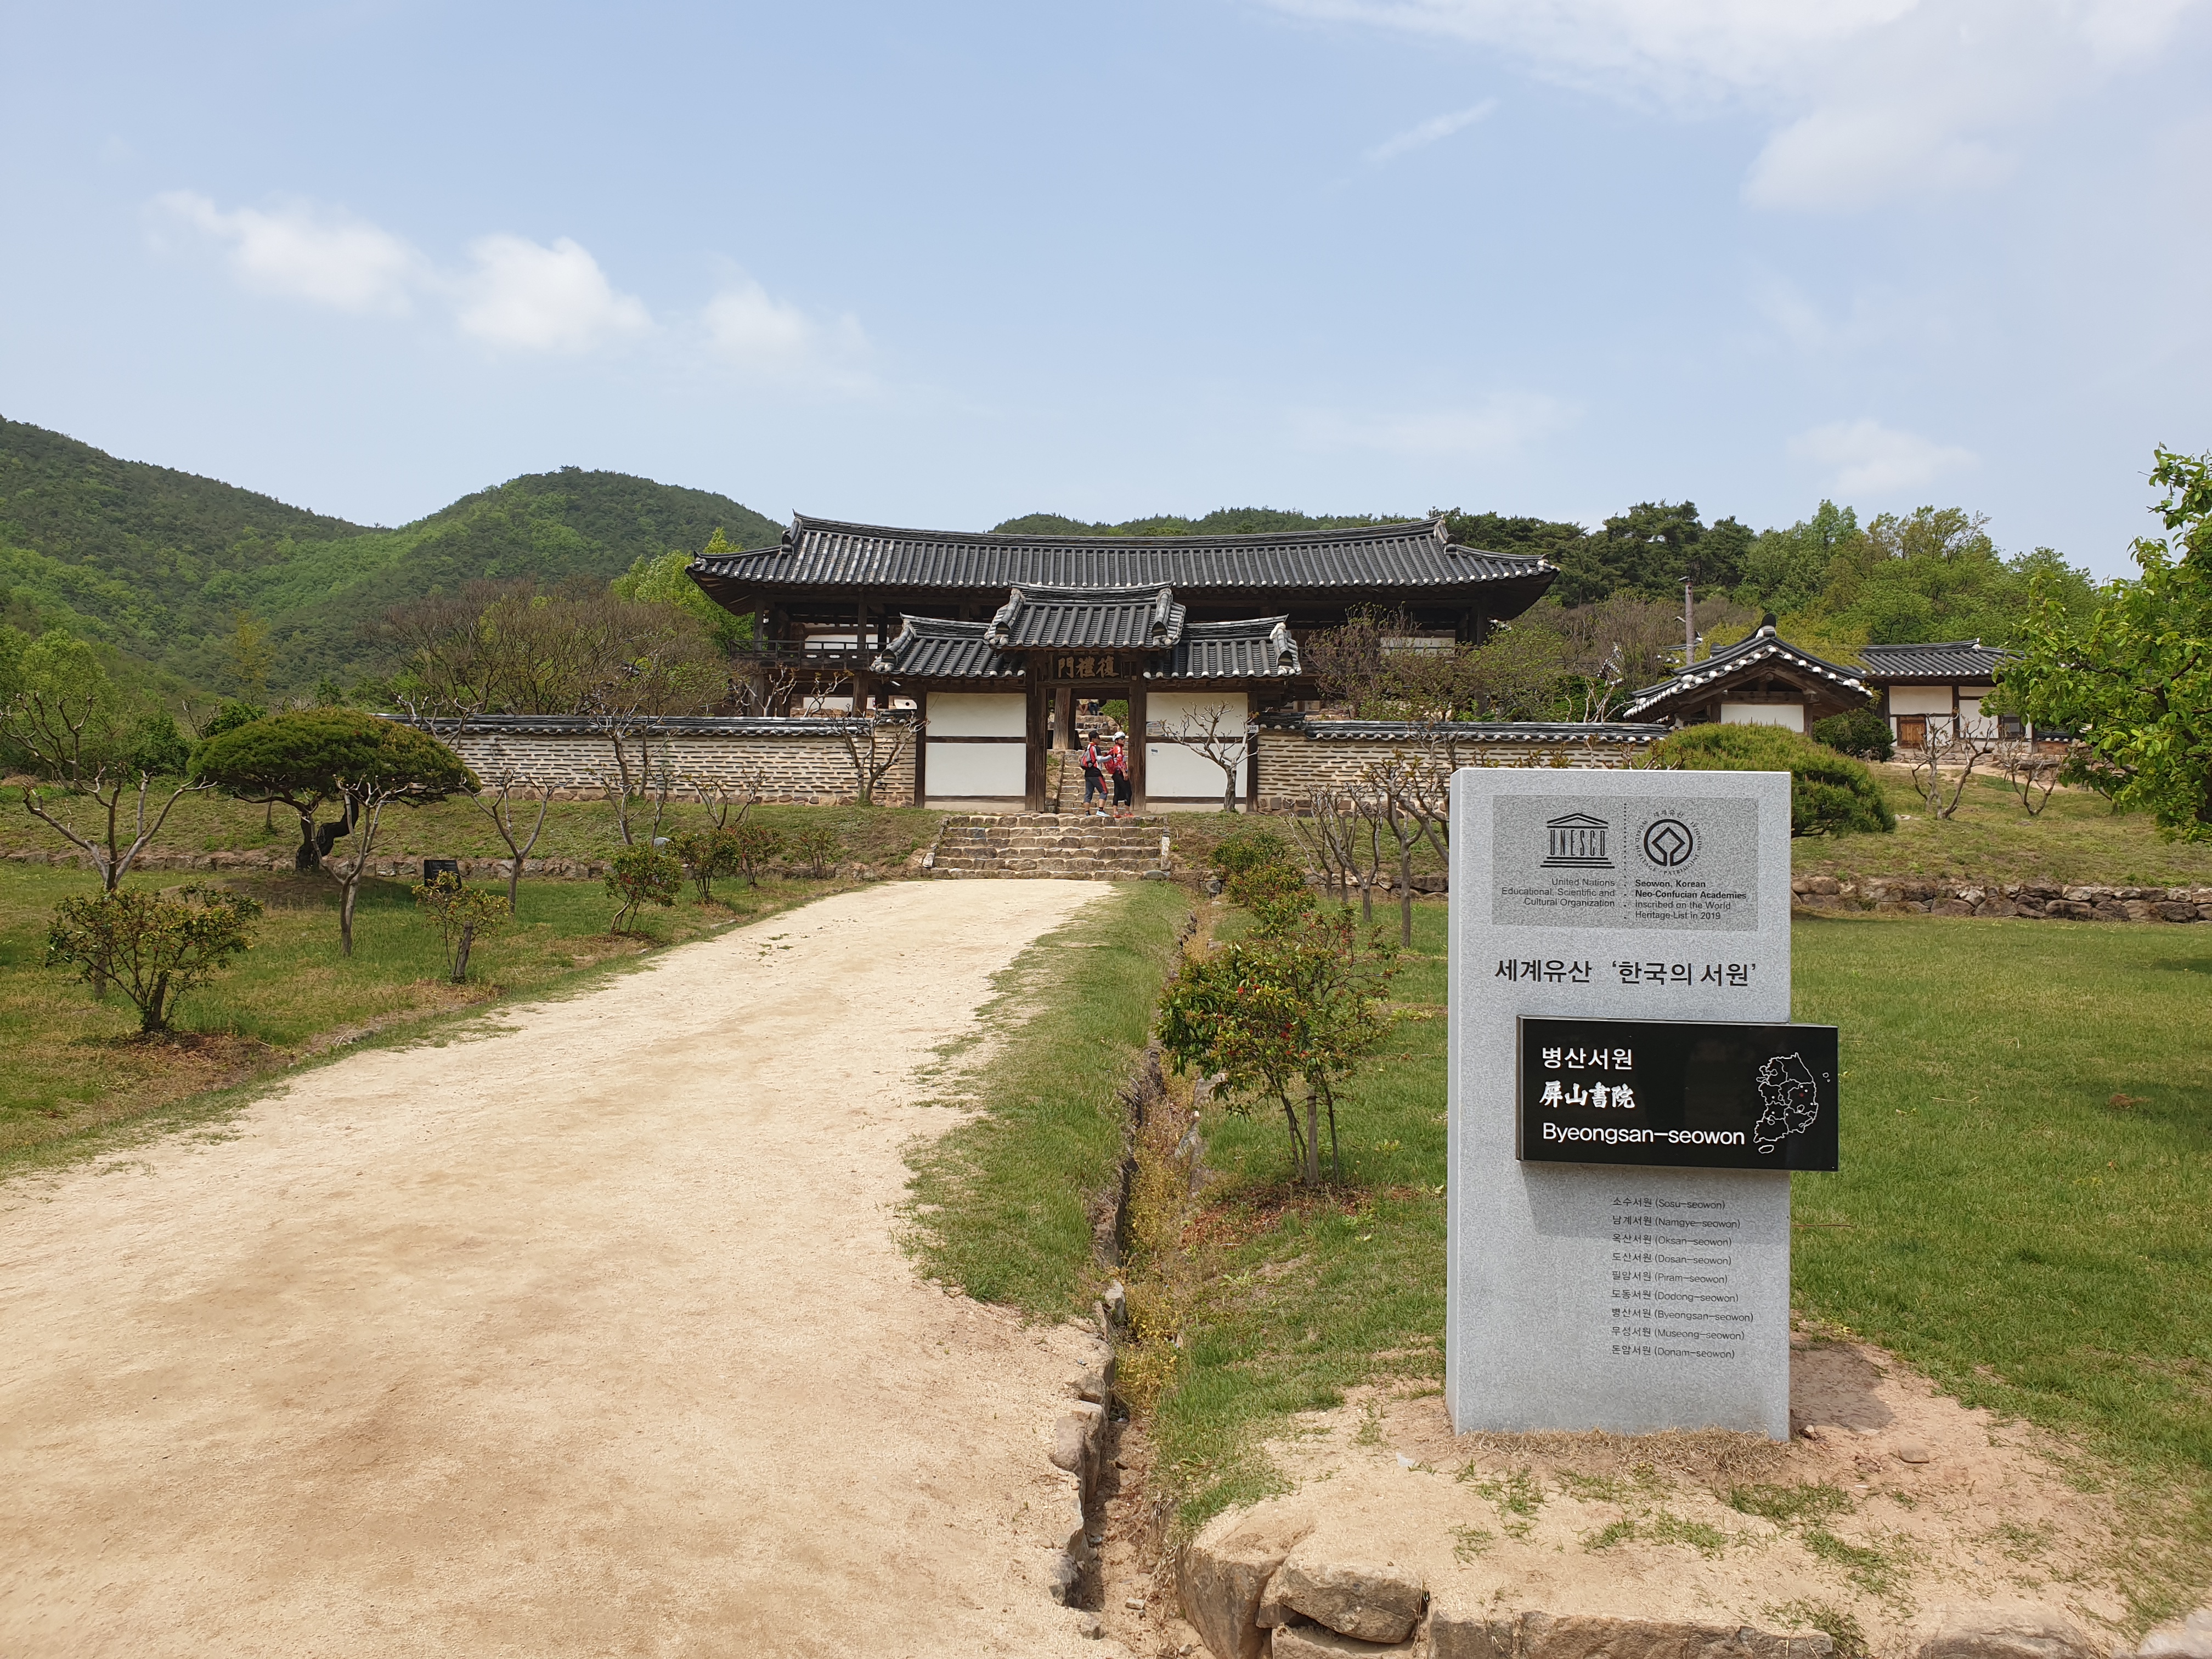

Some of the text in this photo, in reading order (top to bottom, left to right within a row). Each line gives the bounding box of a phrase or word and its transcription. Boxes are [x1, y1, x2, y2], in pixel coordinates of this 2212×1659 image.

[1550, 830, 1605, 856] UNESCO
[1635, 879, 1672, 888] Seowon,
[1502, 887, 1554, 896] Educational,
[1635, 890, 1697, 898] Neo-Confucian
[1560, 898, 1615, 907] Organization
[1635, 900, 1673, 909] inscribed
[1705, 901, 1731, 910] World
[1635, 911, 1670, 920] Heritage
[1494, 958, 1592, 984] 세계유산
[1542, 1047, 1633, 1070] 병산서원
[1543, 1122, 1745, 1144] Byeongsan-seowon
[1612, 1197, 1652, 1207] 소수서원
[1612, 1216, 1652, 1226] 남계서원
[1612, 1234, 1651, 1244] 옥산서원
[1612, 1252, 1651, 1262] 도산서원
[1612, 1271, 1651, 1281] 필암서원
[1611, 1290, 1651, 1300] 도동서원
[1612, 1308, 1651, 1318] 병산서원
[1612, 1327, 1651, 1337] 무성서원
[1612, 1345, 1651, 1356] 돈암서원
